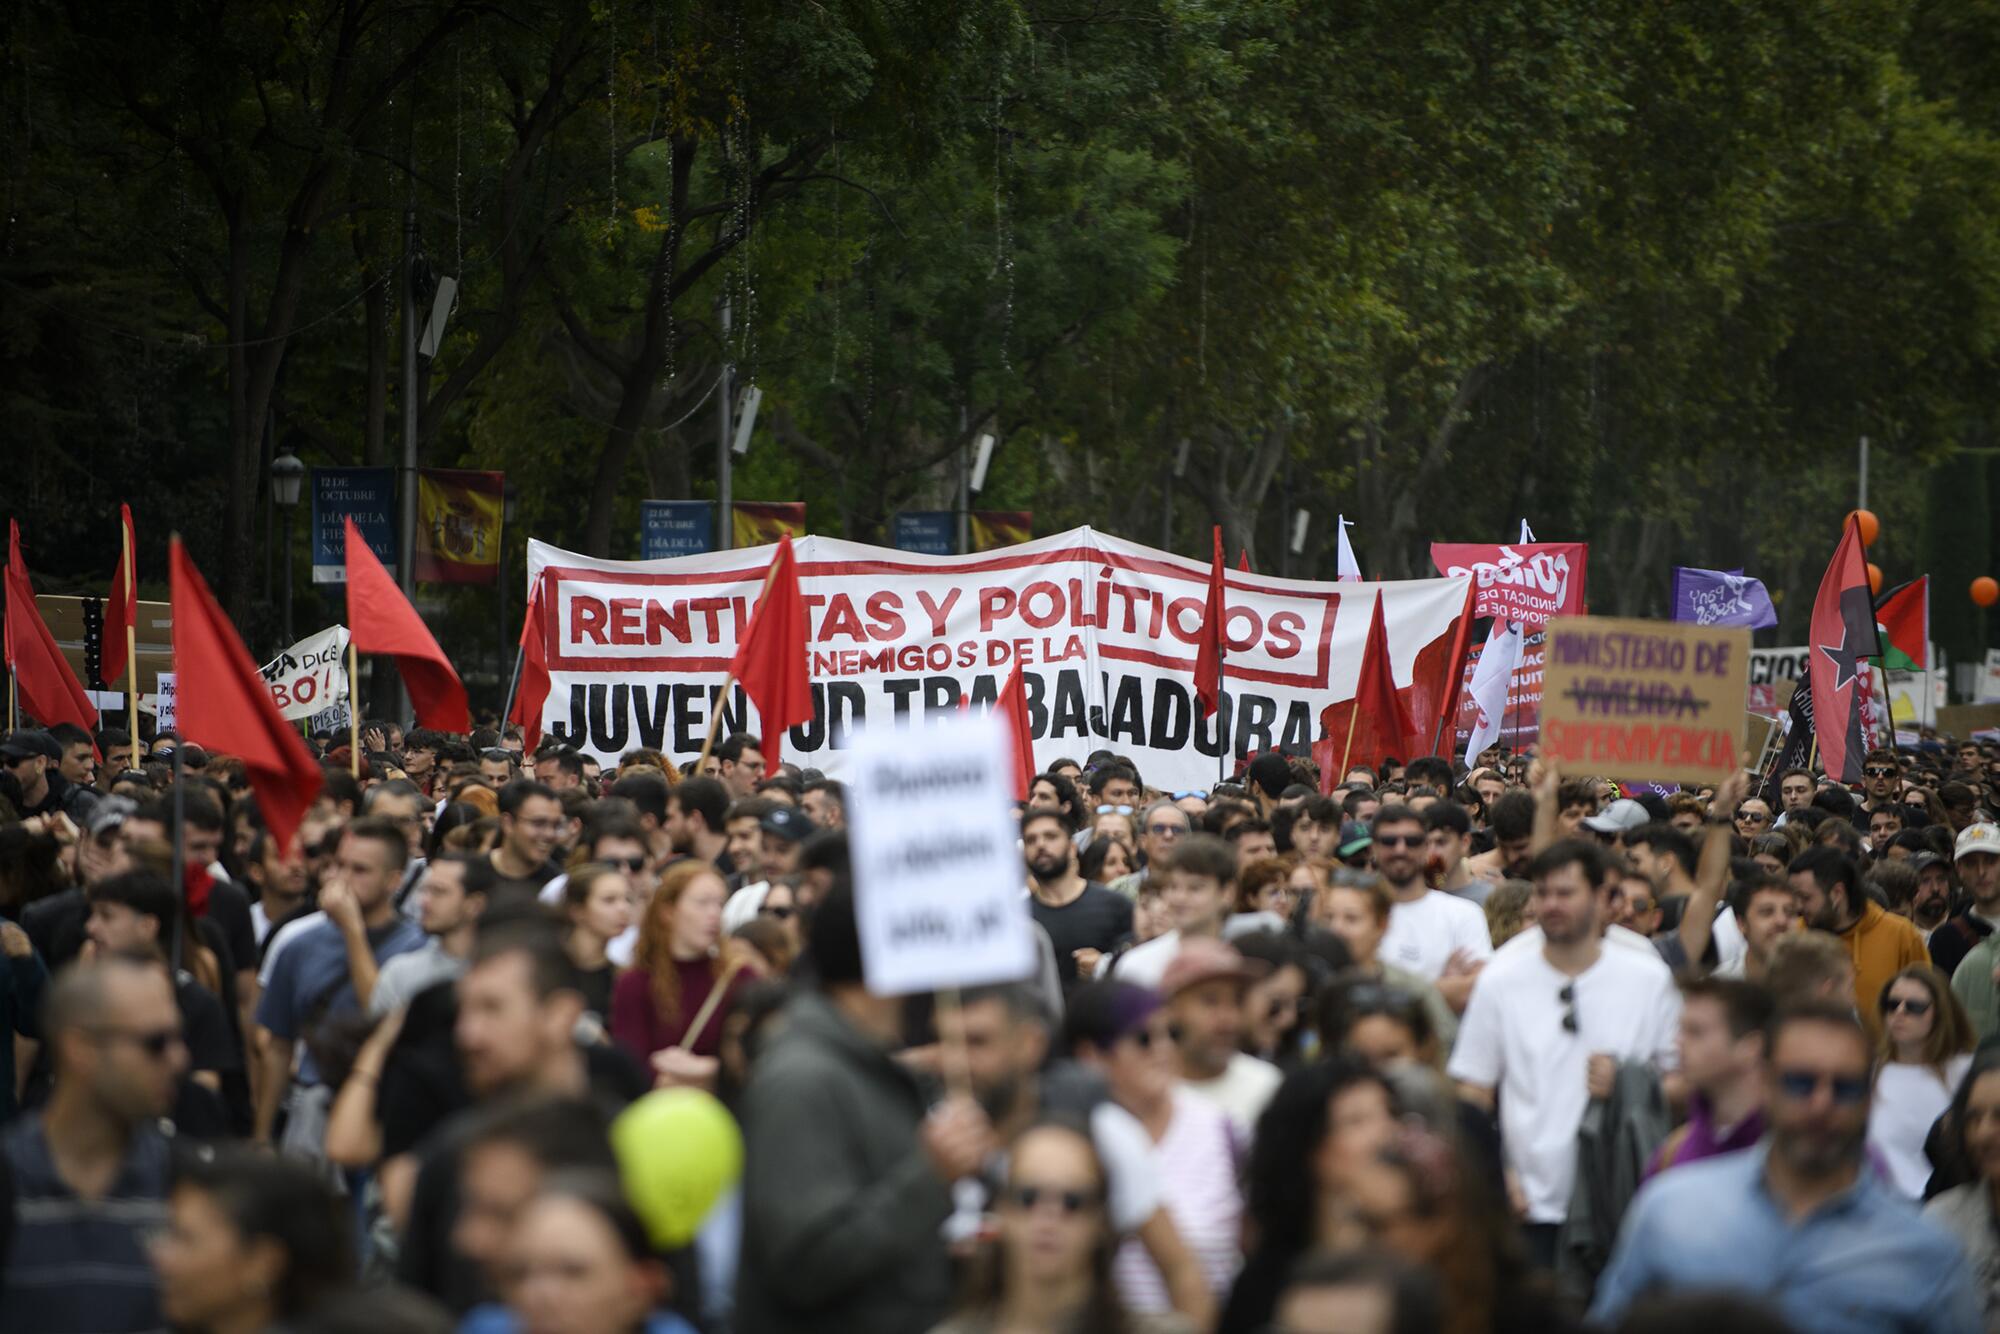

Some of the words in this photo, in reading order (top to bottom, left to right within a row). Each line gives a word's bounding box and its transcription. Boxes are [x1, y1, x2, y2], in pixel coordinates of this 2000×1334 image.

[320, 490, 376, 500] OCTUBRE
[570, 588, 907, 646] RENTITAS
[915, 587, 962, 638] Y
[986, 637, 1034, 667] DE
[1043, 634, 1087, 664] LA
[1552, 630, 1686, 672] MINISTERIO
[1693, 640, 1731, 677] DE
[552, 680, 867, 754] JUVENUD
